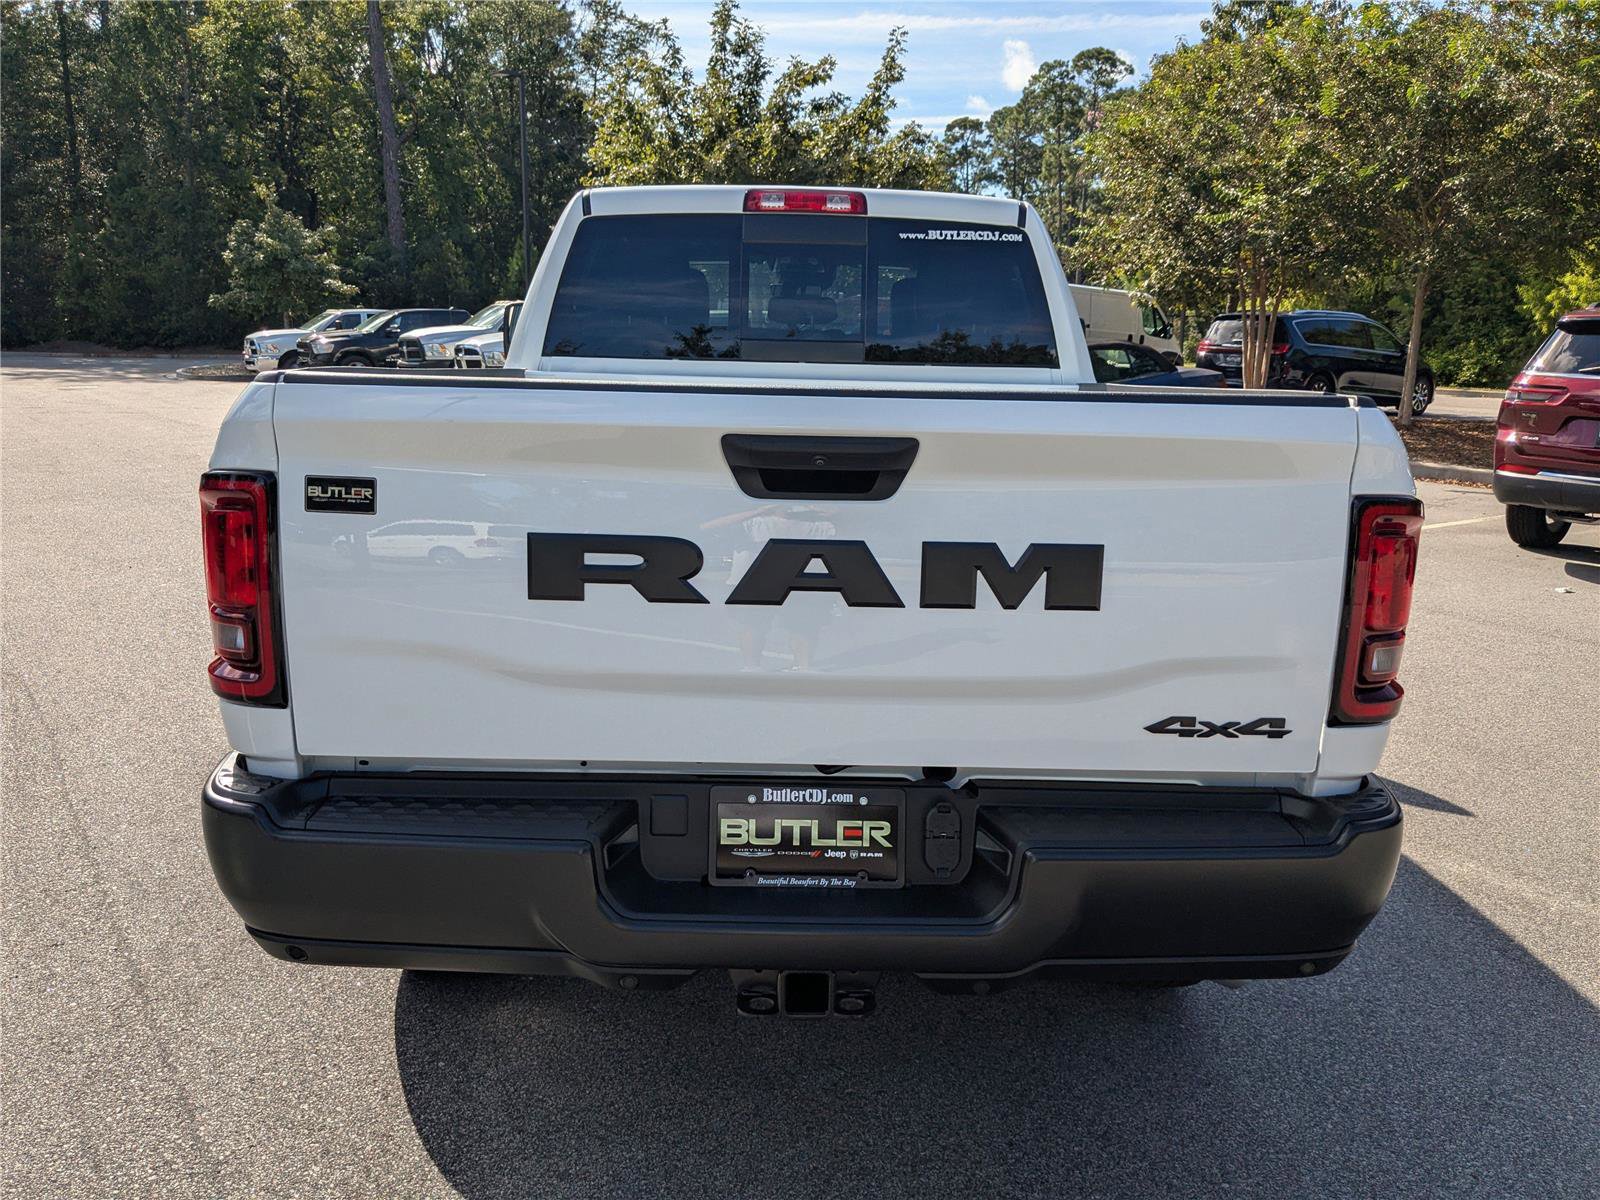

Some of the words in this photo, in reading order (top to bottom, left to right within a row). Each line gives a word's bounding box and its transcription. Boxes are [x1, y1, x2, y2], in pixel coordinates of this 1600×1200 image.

[307, 486, 373, 499] BUTLER
[527, 532, 1105, 611] RAM
[1143, 716, 1293, 739] 4x4
[762, 788, 854, 805] ButlerCDJ.com
[720, 818, 893, 848] BUTLER
[824, 849, 847, 859] Jeep
[757, 877, 789, 885] Beautiful
[789, 878, 819, 886] Beaufort
[819, 878, 829, 887] By
[830, 878, 843, 886] The
[843, 879, 857, 888] Bay
